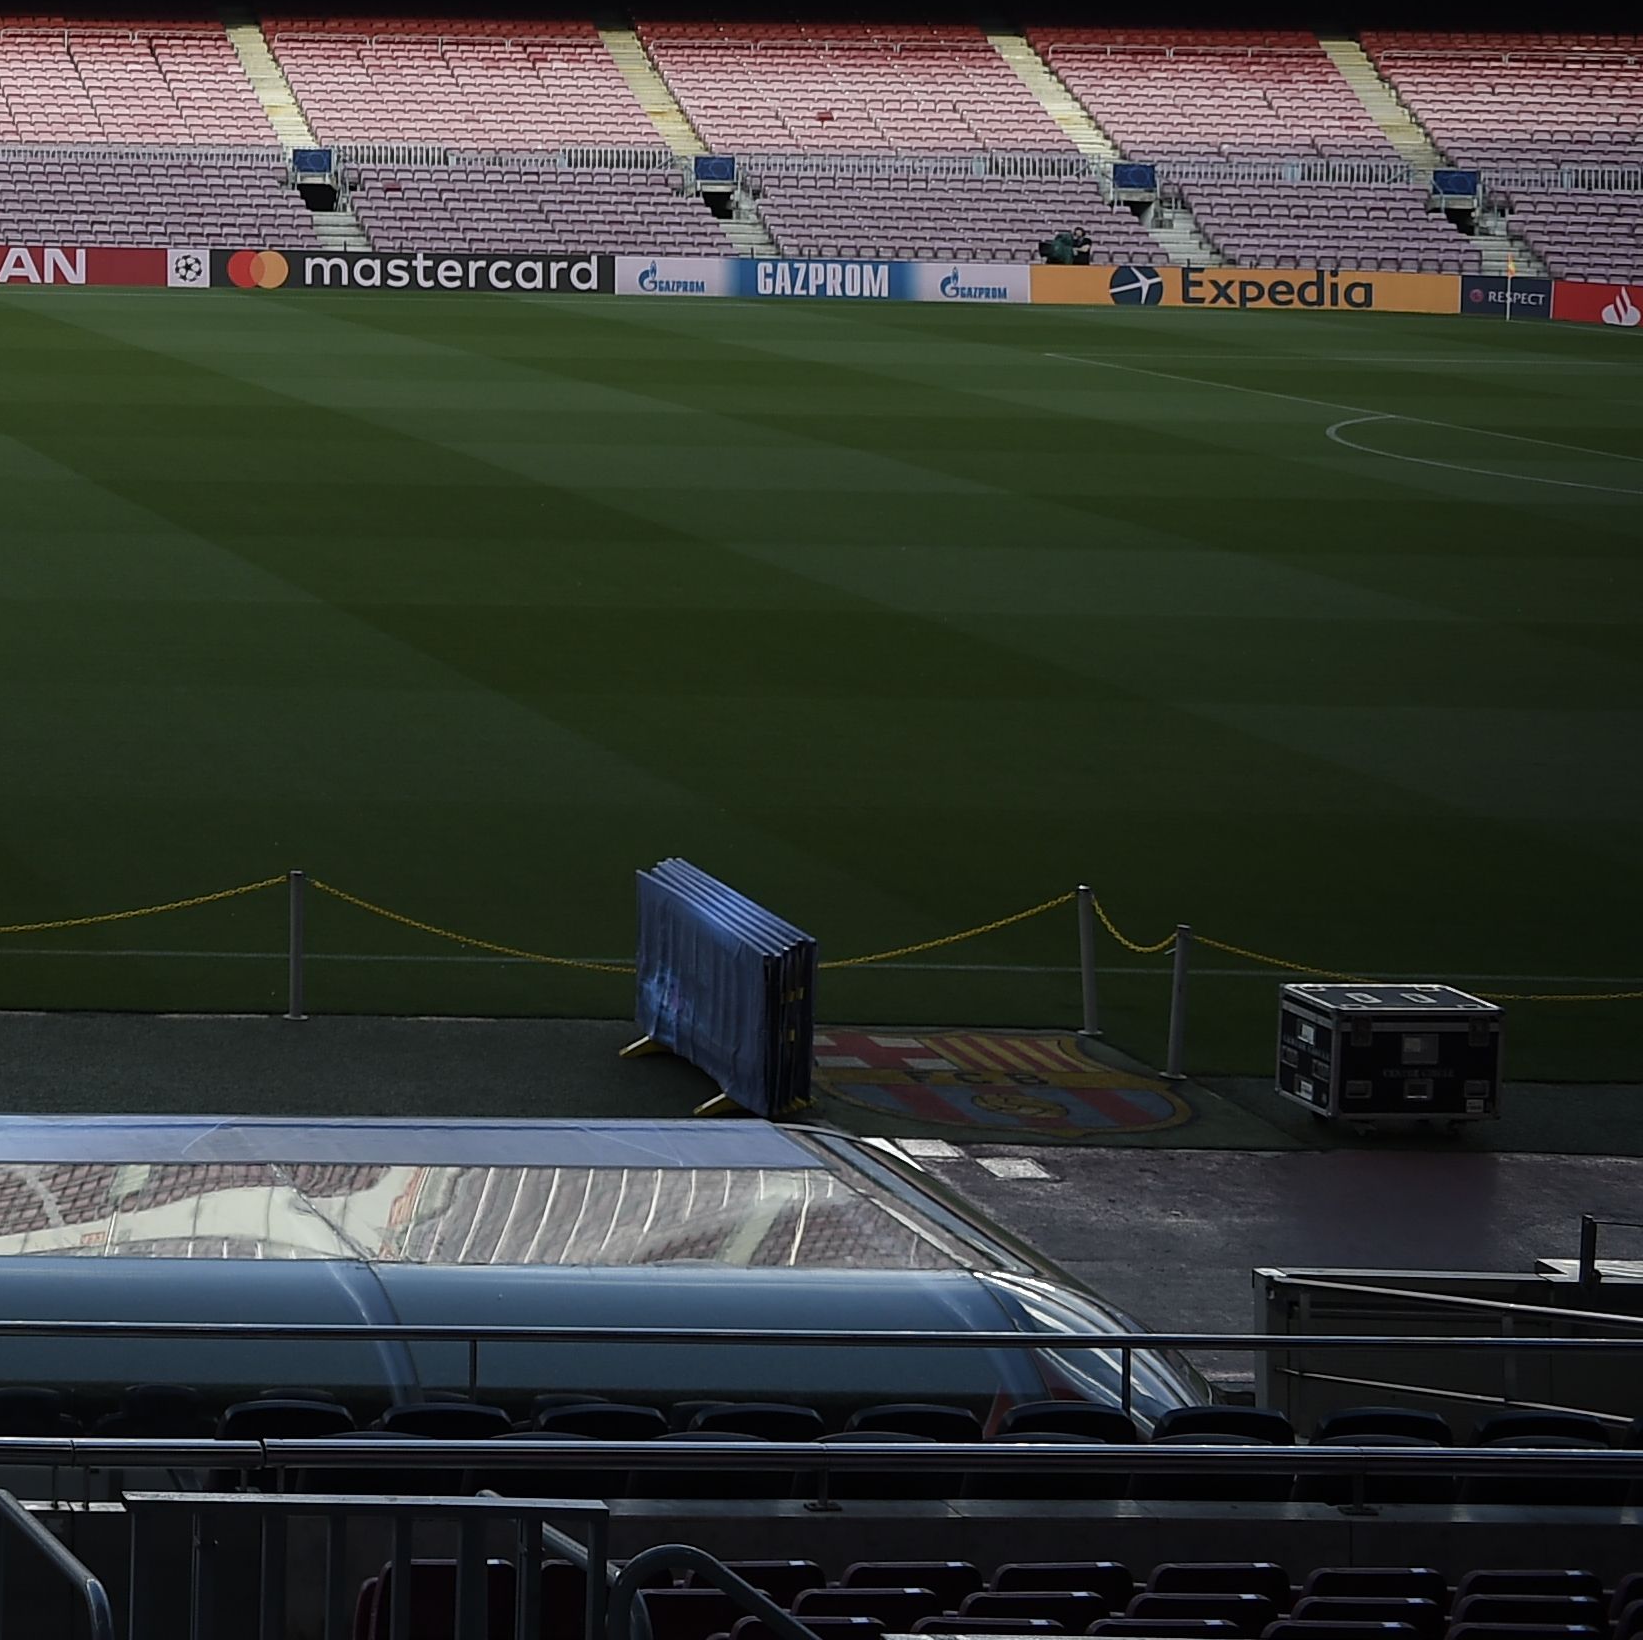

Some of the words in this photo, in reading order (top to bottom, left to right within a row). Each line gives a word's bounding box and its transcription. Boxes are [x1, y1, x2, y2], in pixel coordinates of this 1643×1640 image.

[304, 253, 598, 291] mastercard
[757, 264, 889, 297] GAZPROM
[657, 280, 705, 293] GAZPROM
[960, 286, 1007, 299] GAZPROM
[1181, 267, 1374, 309] Expedia
[1488, 291, 1545, 306] RESPECT
